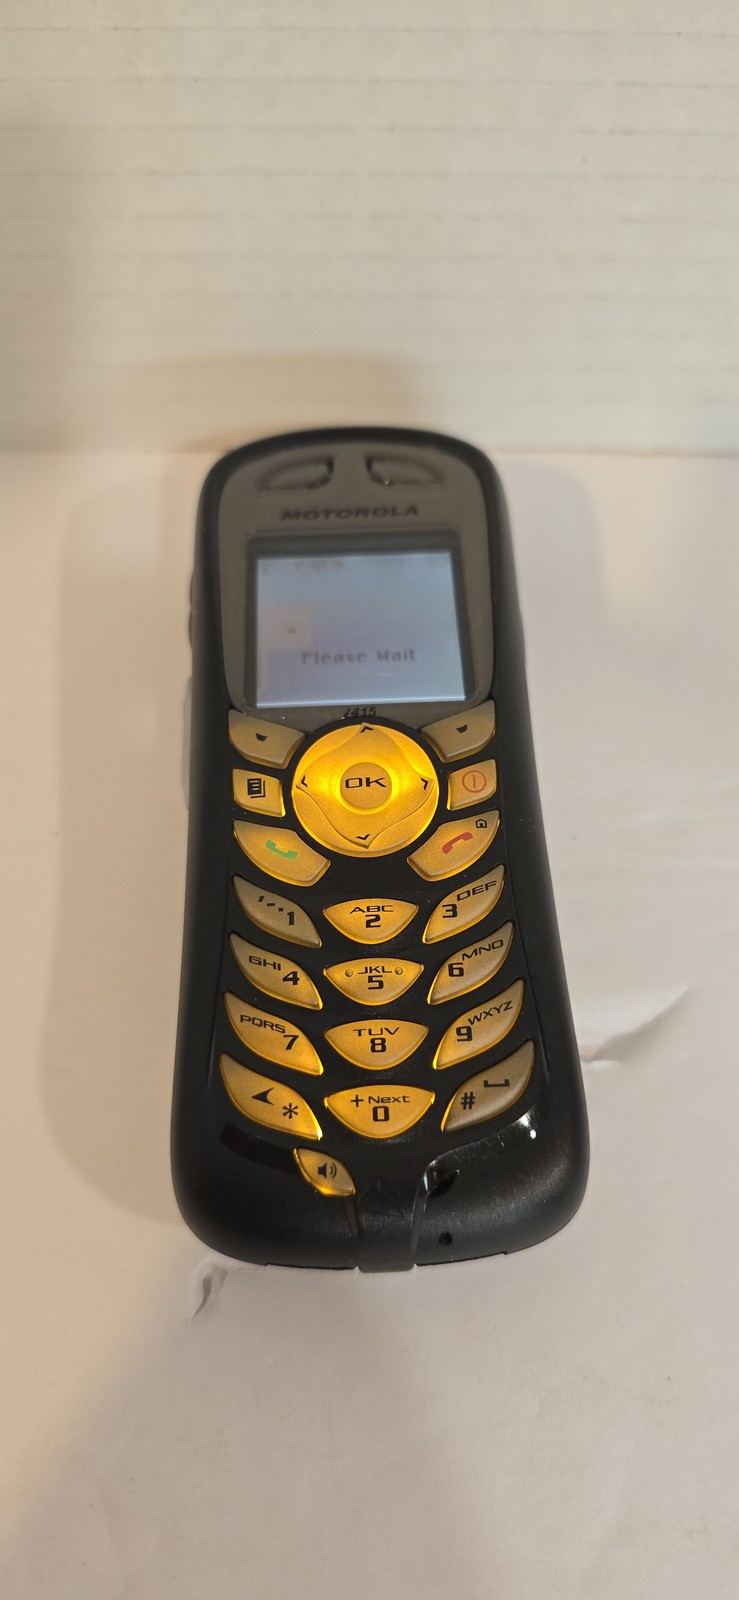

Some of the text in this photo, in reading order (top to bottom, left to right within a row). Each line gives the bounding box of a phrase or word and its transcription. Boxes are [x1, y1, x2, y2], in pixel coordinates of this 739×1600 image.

[281, 504, 419, 522] MOTOROLA
[301, 649, 417, 666] Please Wait
[344, 776, 387, 789] OK
[456, 880, 497, 902] DEF
[350, 904, 394, 915] ABC
[441, 903, 458, 919] 3
[286, 911, 295, 926] 1
[365, 914, 381, 929] 2
[461, 939, 504, 962] MNO
[248, 955, 282, 972] GHI
[357, 965, 393, 975] JKL
[447, 962, 464, 978] 6
[282, 971, 300, 986] 4
[367, 975, 384, 990] 5
[467, 1000, 513, 1026] WXYZ
[239, 1013, 286, 1034] PQRS
[353, 1026, 400, 1037] TUV
[455, 1025, 473, 1042] 9
[283, 1034, 300, 1051] 7
[369, 1037, 387, 1053] 8
[367, 1095, 411, 1104] Next
[460, 1091, 476, 1110] #
[372, 1105, 390, 1122] 0
